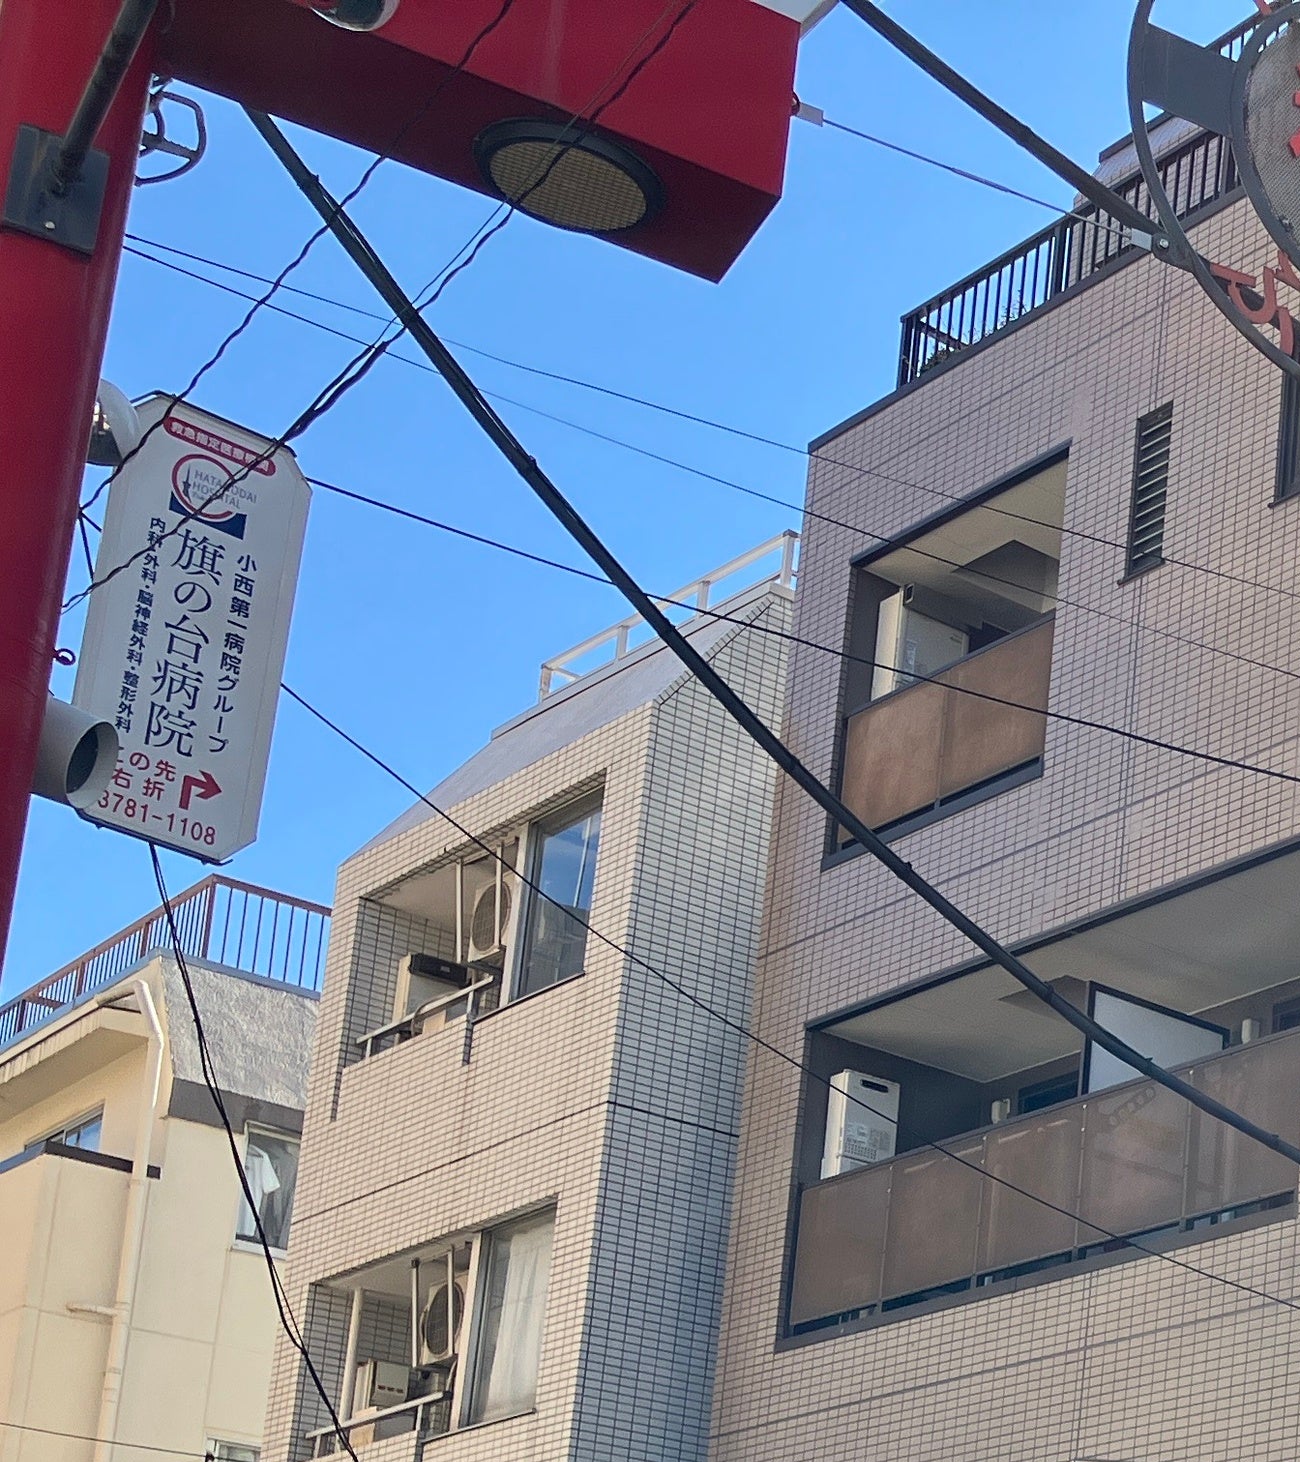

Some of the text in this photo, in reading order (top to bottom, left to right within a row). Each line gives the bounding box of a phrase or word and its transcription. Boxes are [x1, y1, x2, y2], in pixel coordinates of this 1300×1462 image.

[194, 470, 257, 504] HATAODAI
[143, 527, 226, 759] 旗の台病院
[208, 554, 258, 753] 小西第一病院グループ
[112, 767, 166, 802] 右折
[98, 789, 216, 845] 3781-1108
